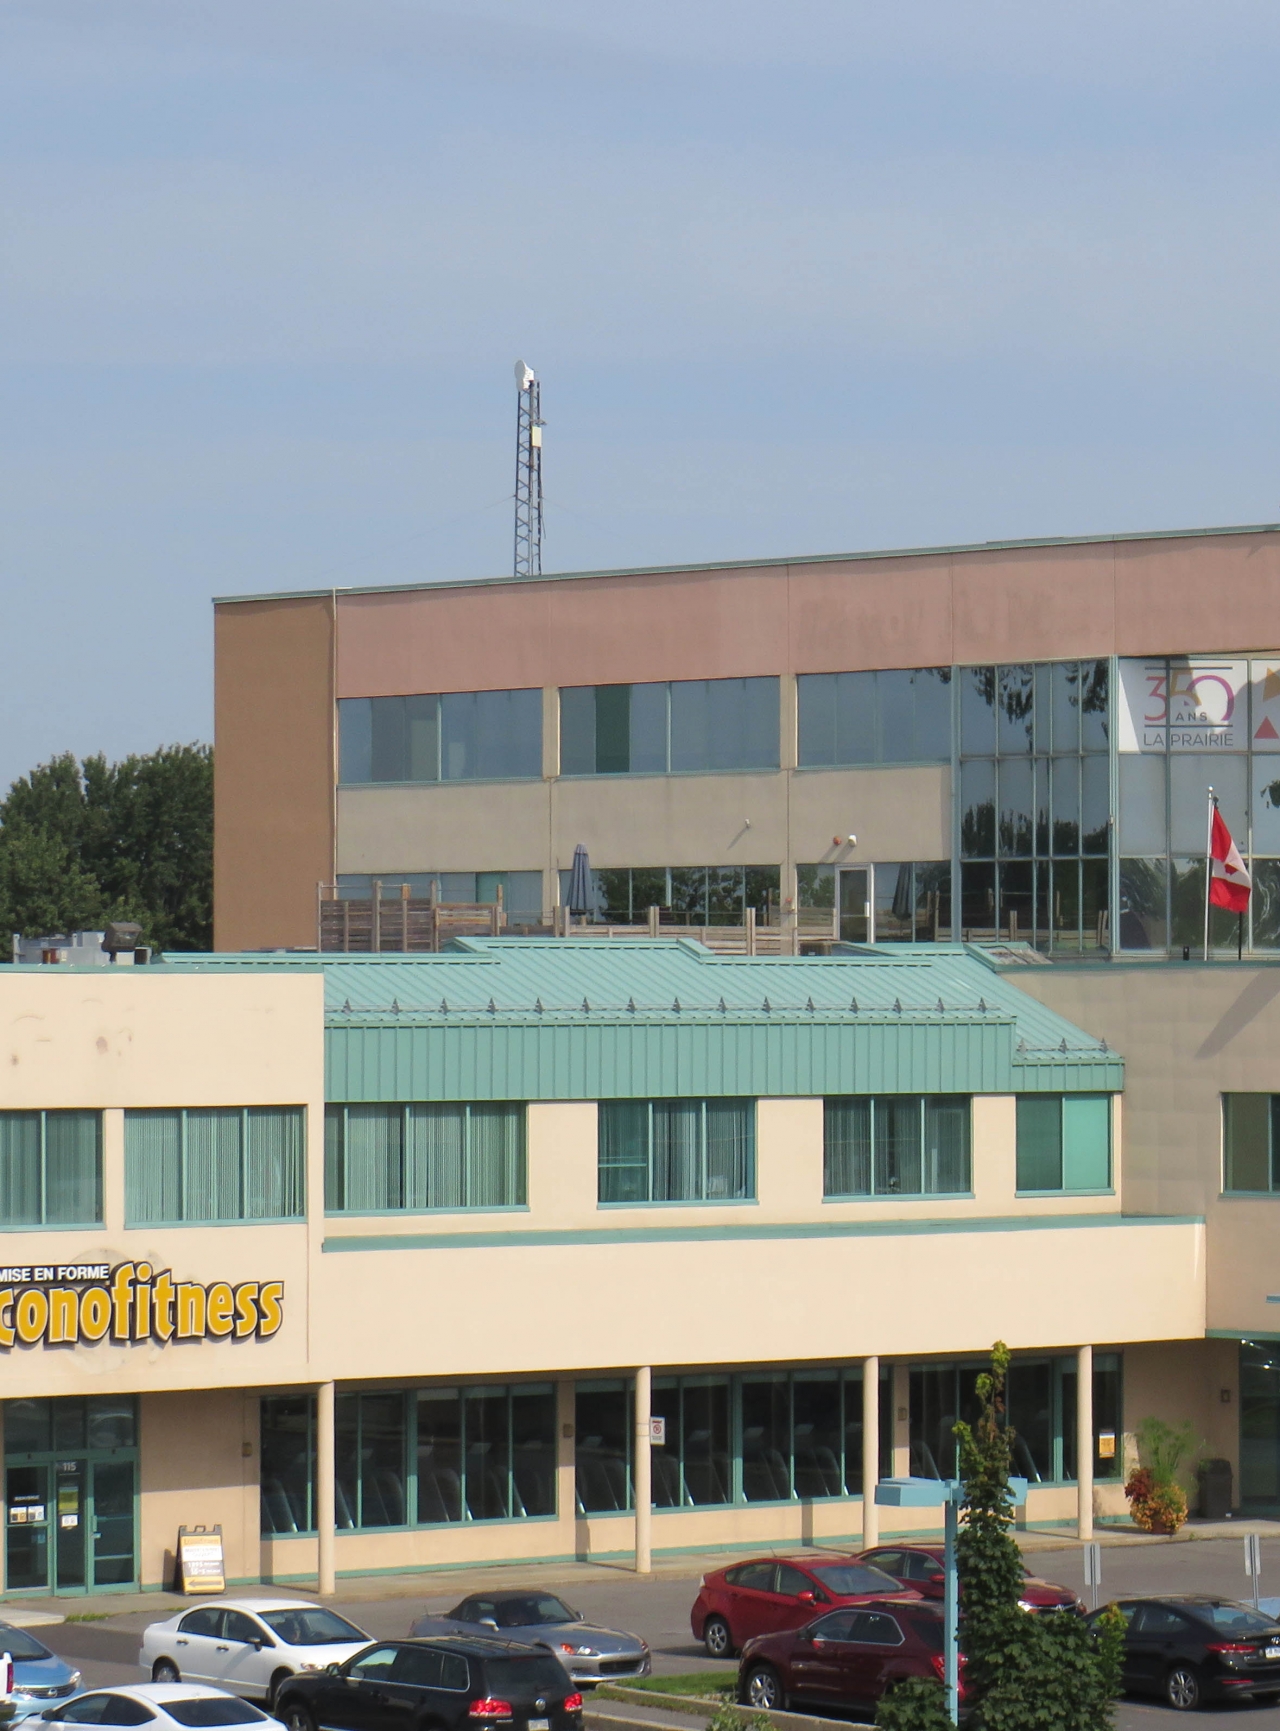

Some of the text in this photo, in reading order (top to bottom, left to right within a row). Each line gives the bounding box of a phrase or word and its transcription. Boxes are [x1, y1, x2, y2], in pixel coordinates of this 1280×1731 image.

[1144, 669, 1235, 721] 350
[1175, 711, 1208, 722] ANS
[1143, 733, 1233, 746] LA PRAIRIE
[34, 1267, 54, 1281] EN
[57, 1265, 109, 1281] FORME
[62, 1462, 76, 1471] 115
